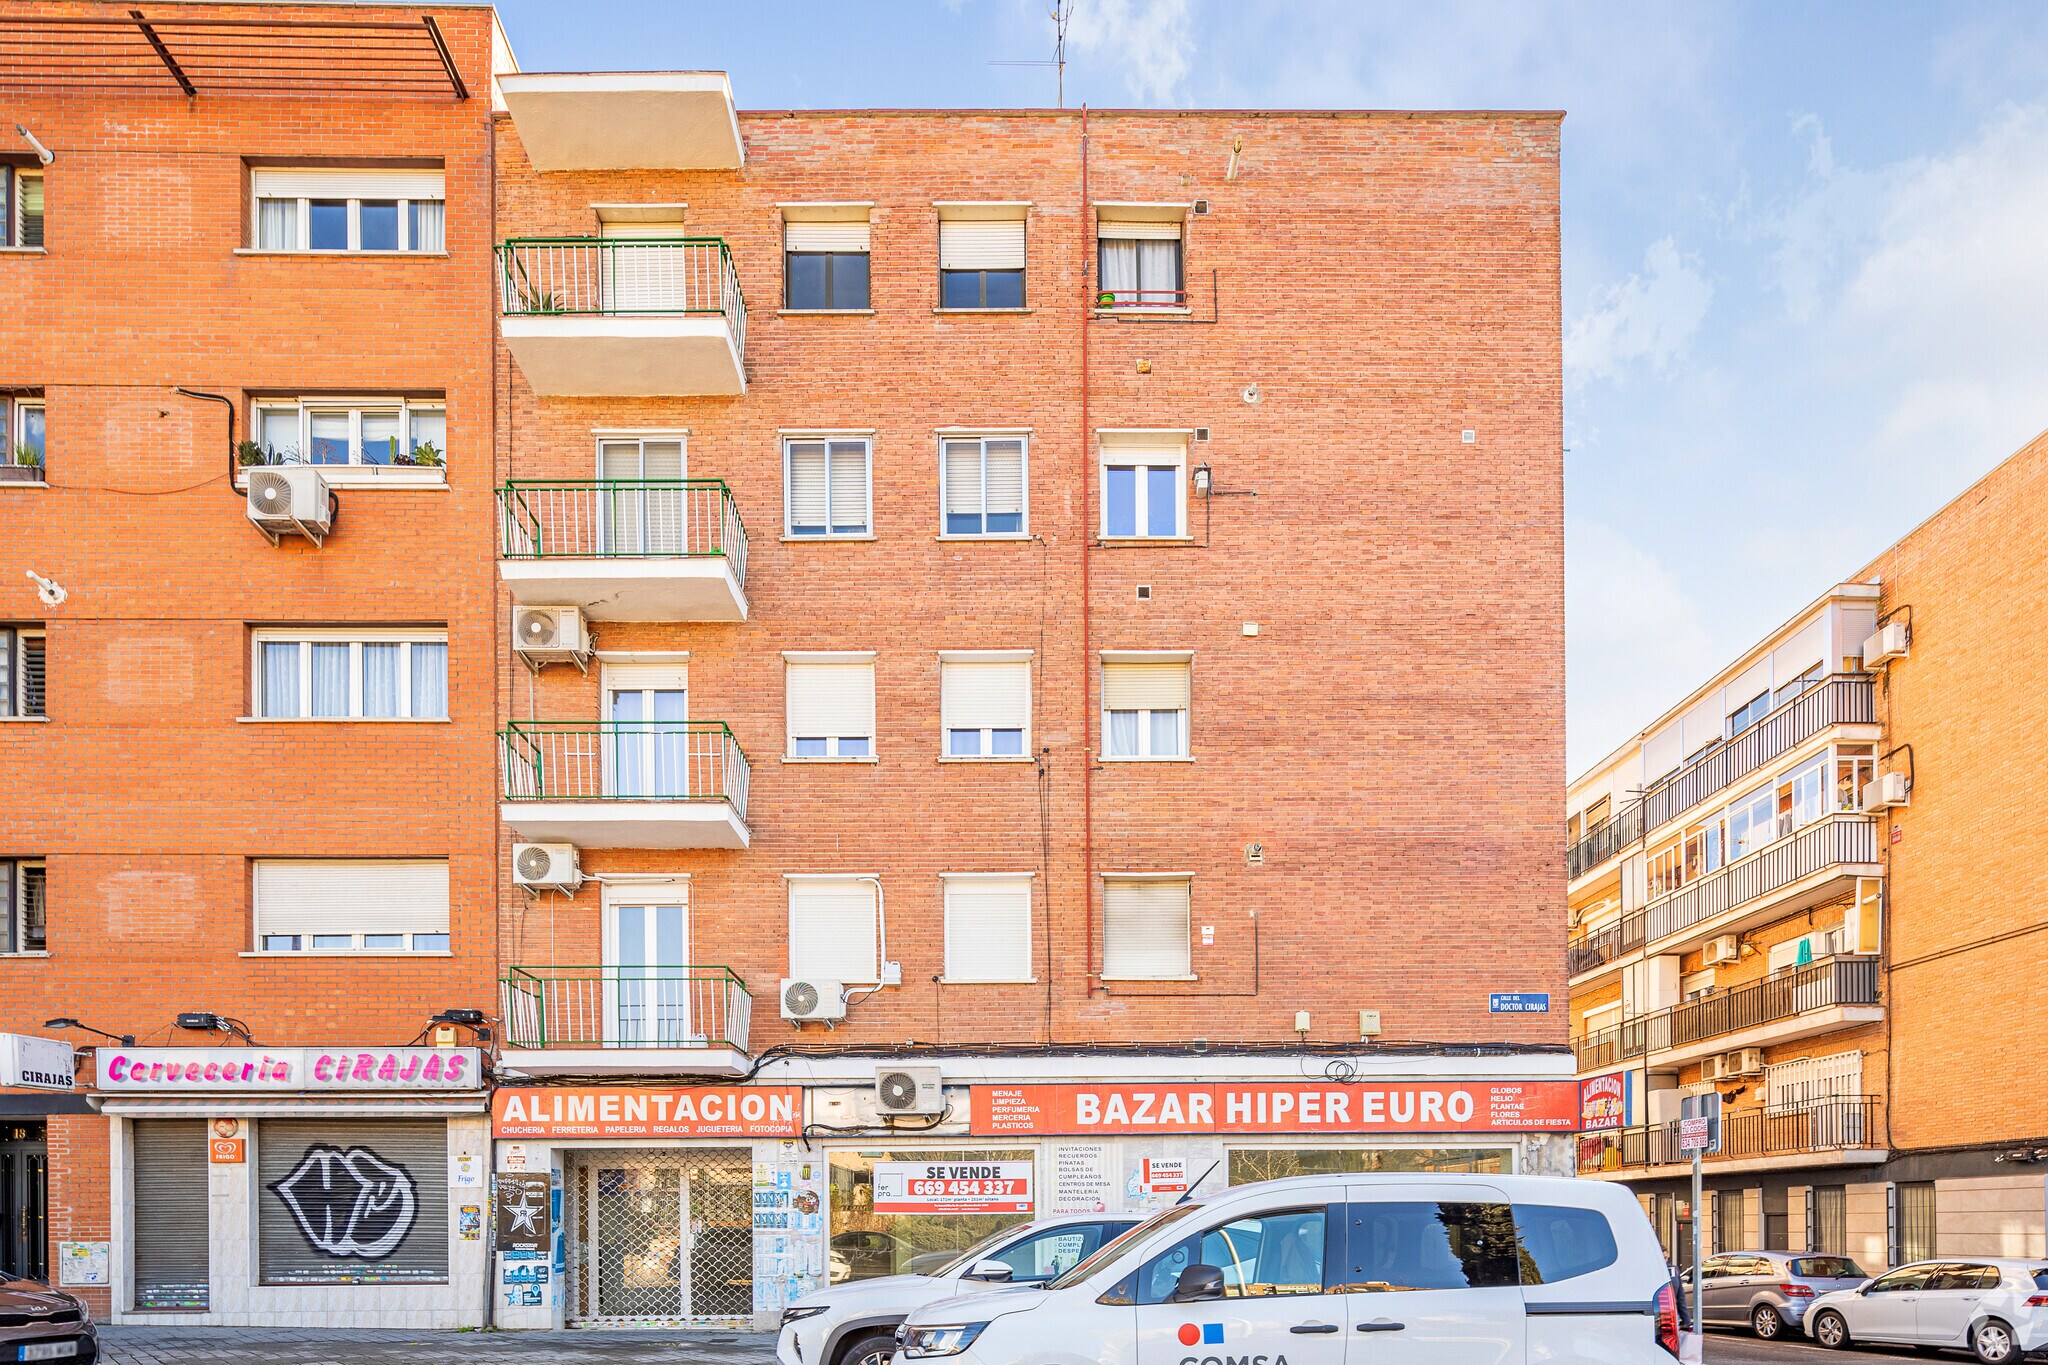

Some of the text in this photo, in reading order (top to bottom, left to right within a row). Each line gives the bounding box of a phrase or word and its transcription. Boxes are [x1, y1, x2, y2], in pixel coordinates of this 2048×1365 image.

[1525, 1003, 1546, 1012] CIRAJAS
[109, 1053, 465, 1082] Cerveceria CIRAJAS
[22, 1070, 73, 1086] CIRAJAS
[1584, 1076, 1621, 1101] ALIMENTACION
[502, 1093, 793, 1122] ALIMENTACION
[1076, 1090, 1475, 1125] BAZAR HIPER EURO
[1546, 1118, 1571, 1126] FIESTA
[1585, 1116, 1618, 1129] BAZAR
[1684, 1118, 1706, 1127] COMPRO
[501, 1125, 793, 1134] CHUCHERIA FERRETERIA PAPELERIA REGALOS JUGUETERIA FOTOCOPIA
[926, 1166, 1001, 1179] SE VENDE
[458, 1174, 475, 1185] Frigo
[913, 1180, 1015, 1195] 669 454 337
